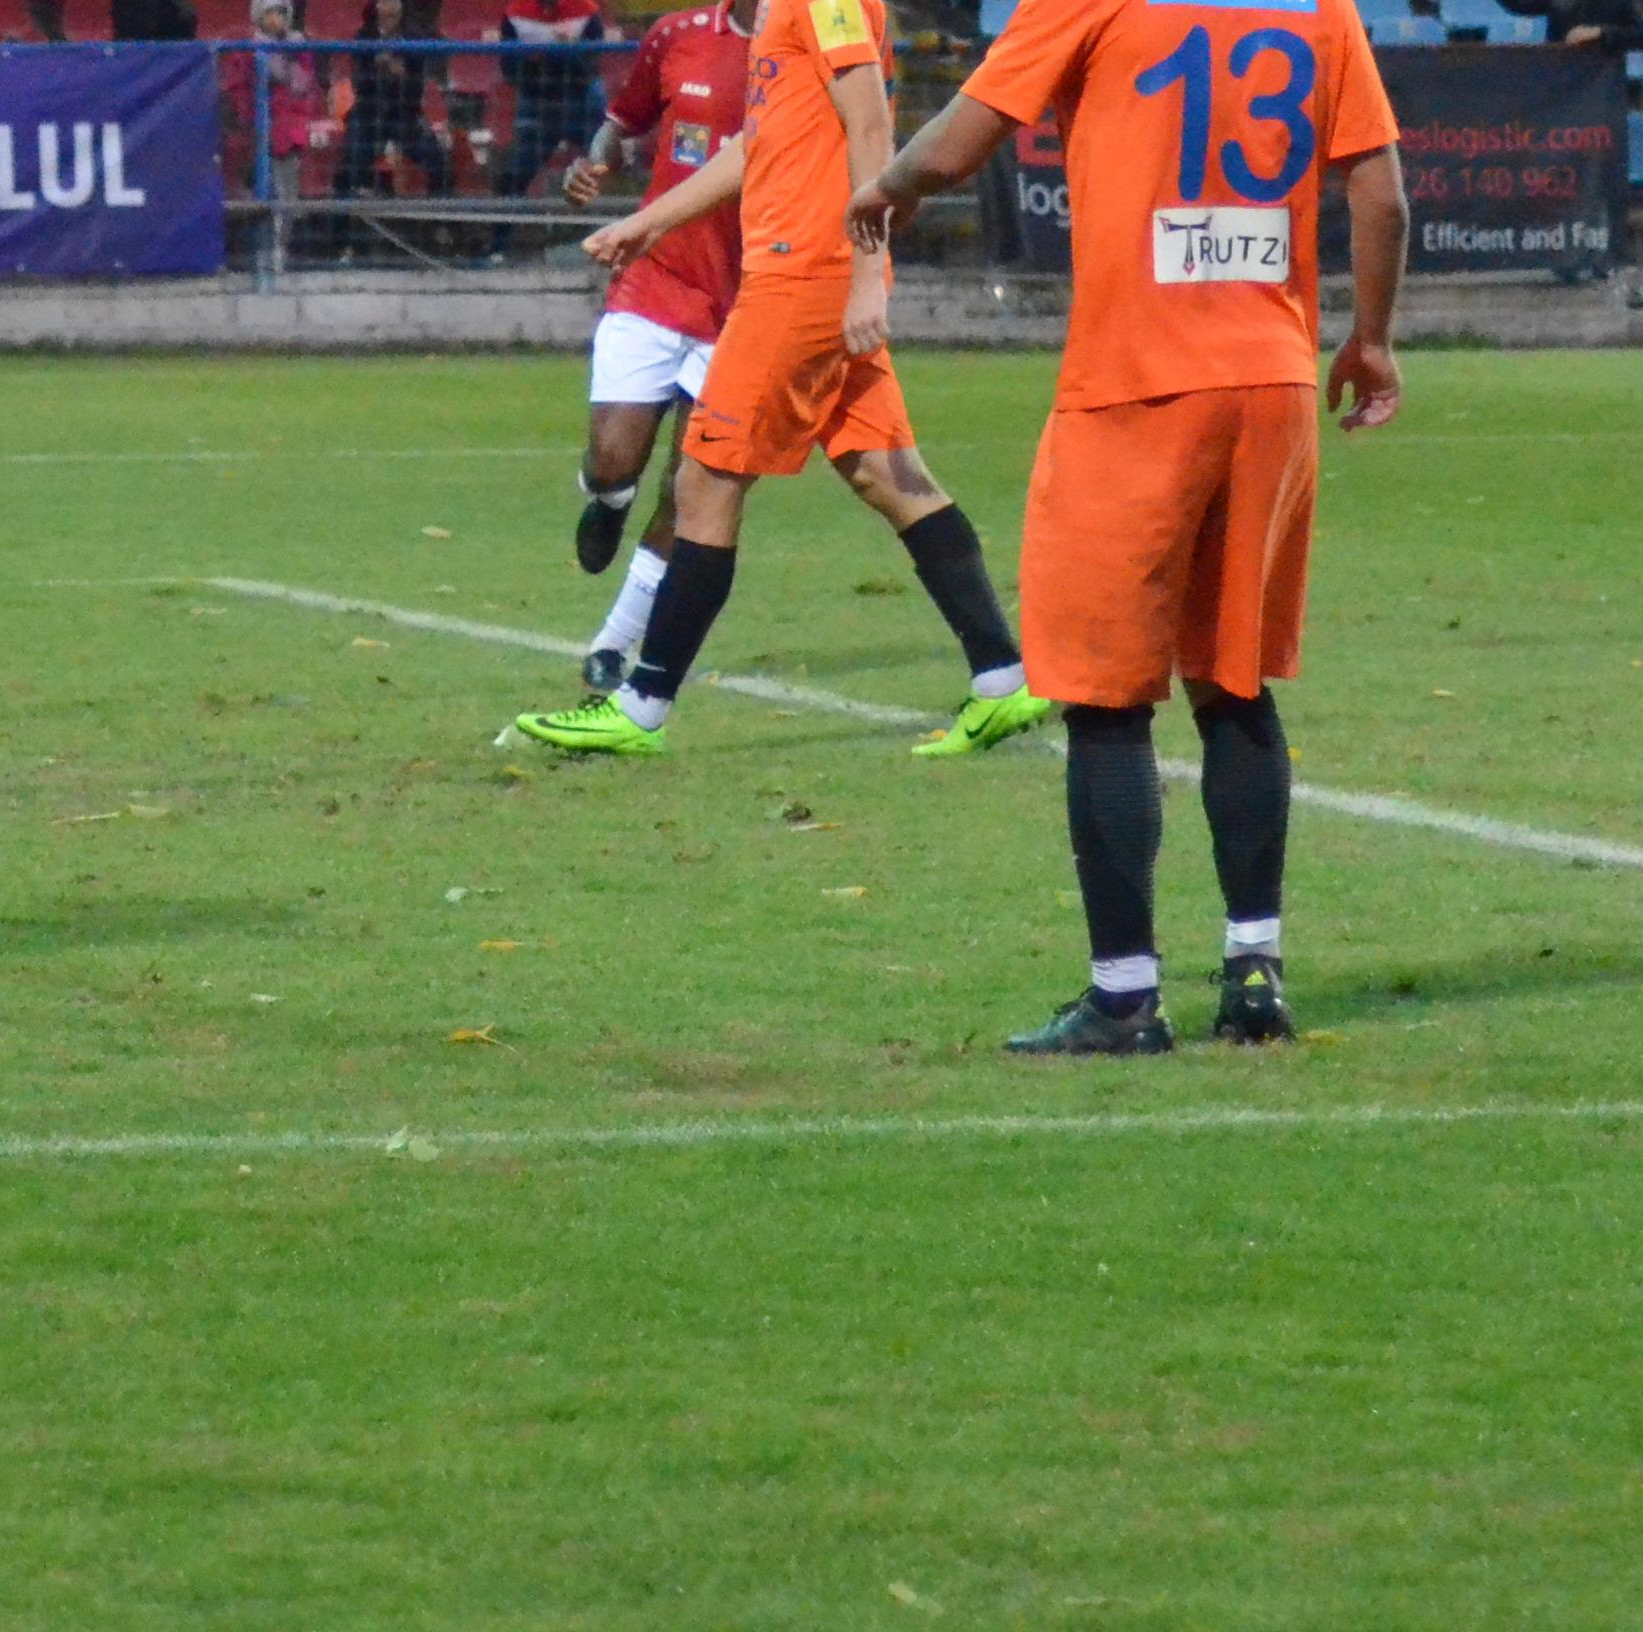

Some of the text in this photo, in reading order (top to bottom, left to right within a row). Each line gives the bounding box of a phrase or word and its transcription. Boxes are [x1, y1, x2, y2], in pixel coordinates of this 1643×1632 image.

[679, 81, 712, 98] JAKO
[1134, 24, 1316, 202] 13
[1423, 222, 1514, 251] Efficient
[1521, 222, 1565, 250] and
